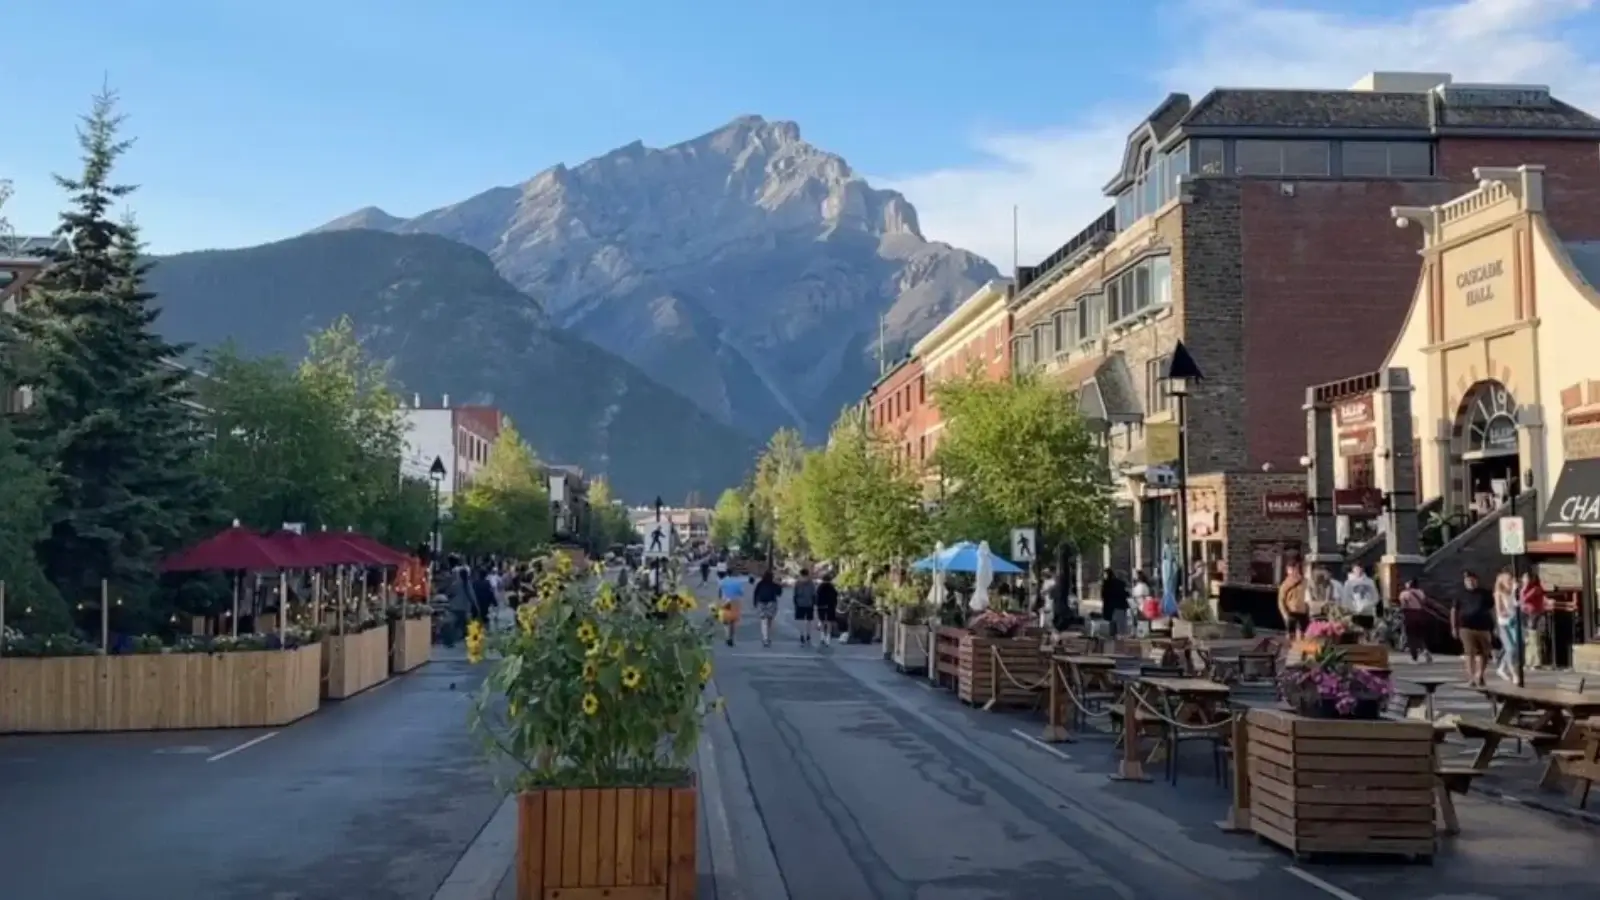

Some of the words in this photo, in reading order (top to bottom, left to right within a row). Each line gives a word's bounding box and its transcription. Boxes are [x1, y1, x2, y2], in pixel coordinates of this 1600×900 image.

[1456, 259, 1504, 289] CASCADE
[1466, 284, 1495, 307] HALL
[1560, 495, 1600, 522] CHA
